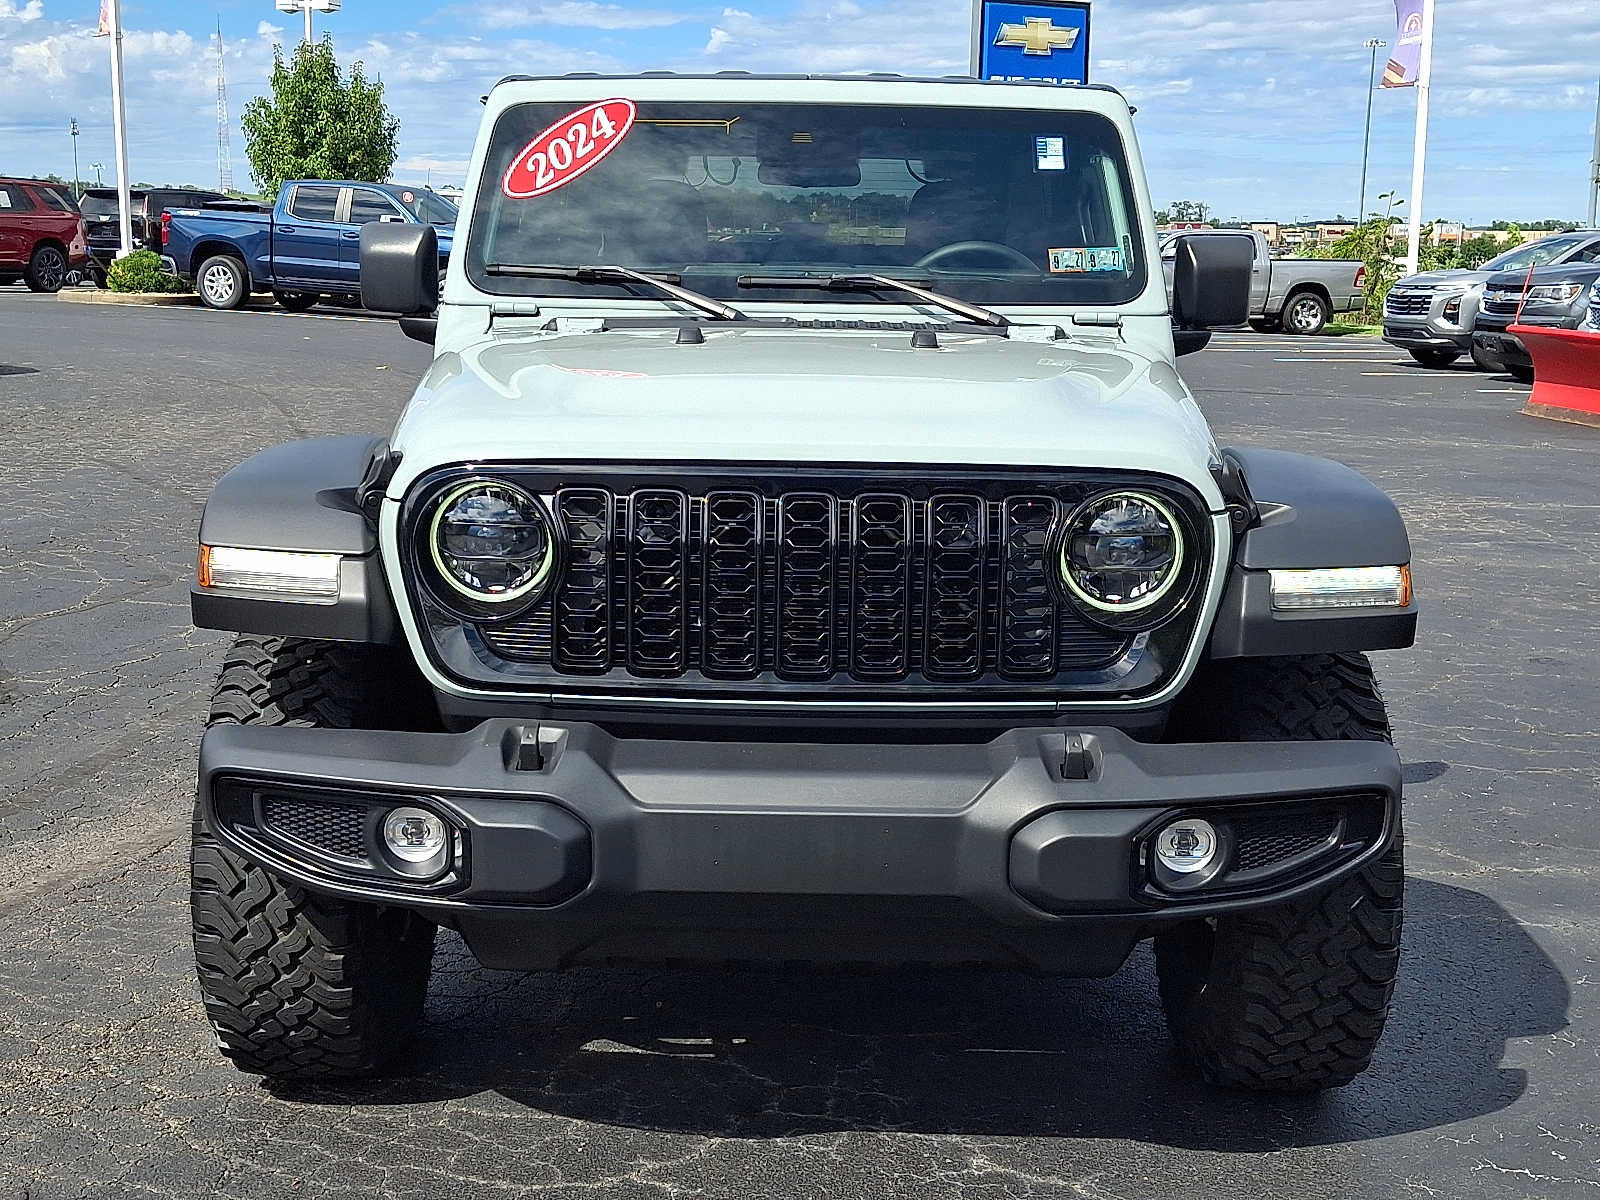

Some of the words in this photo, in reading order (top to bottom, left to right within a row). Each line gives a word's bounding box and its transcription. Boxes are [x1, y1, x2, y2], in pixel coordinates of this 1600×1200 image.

[526, 106, 617, 189] 2024
[1053, 256, 1060, 269] 9
[1089, 254, 1097, 267] 9
[1111, 251, 1120, 266] 27
